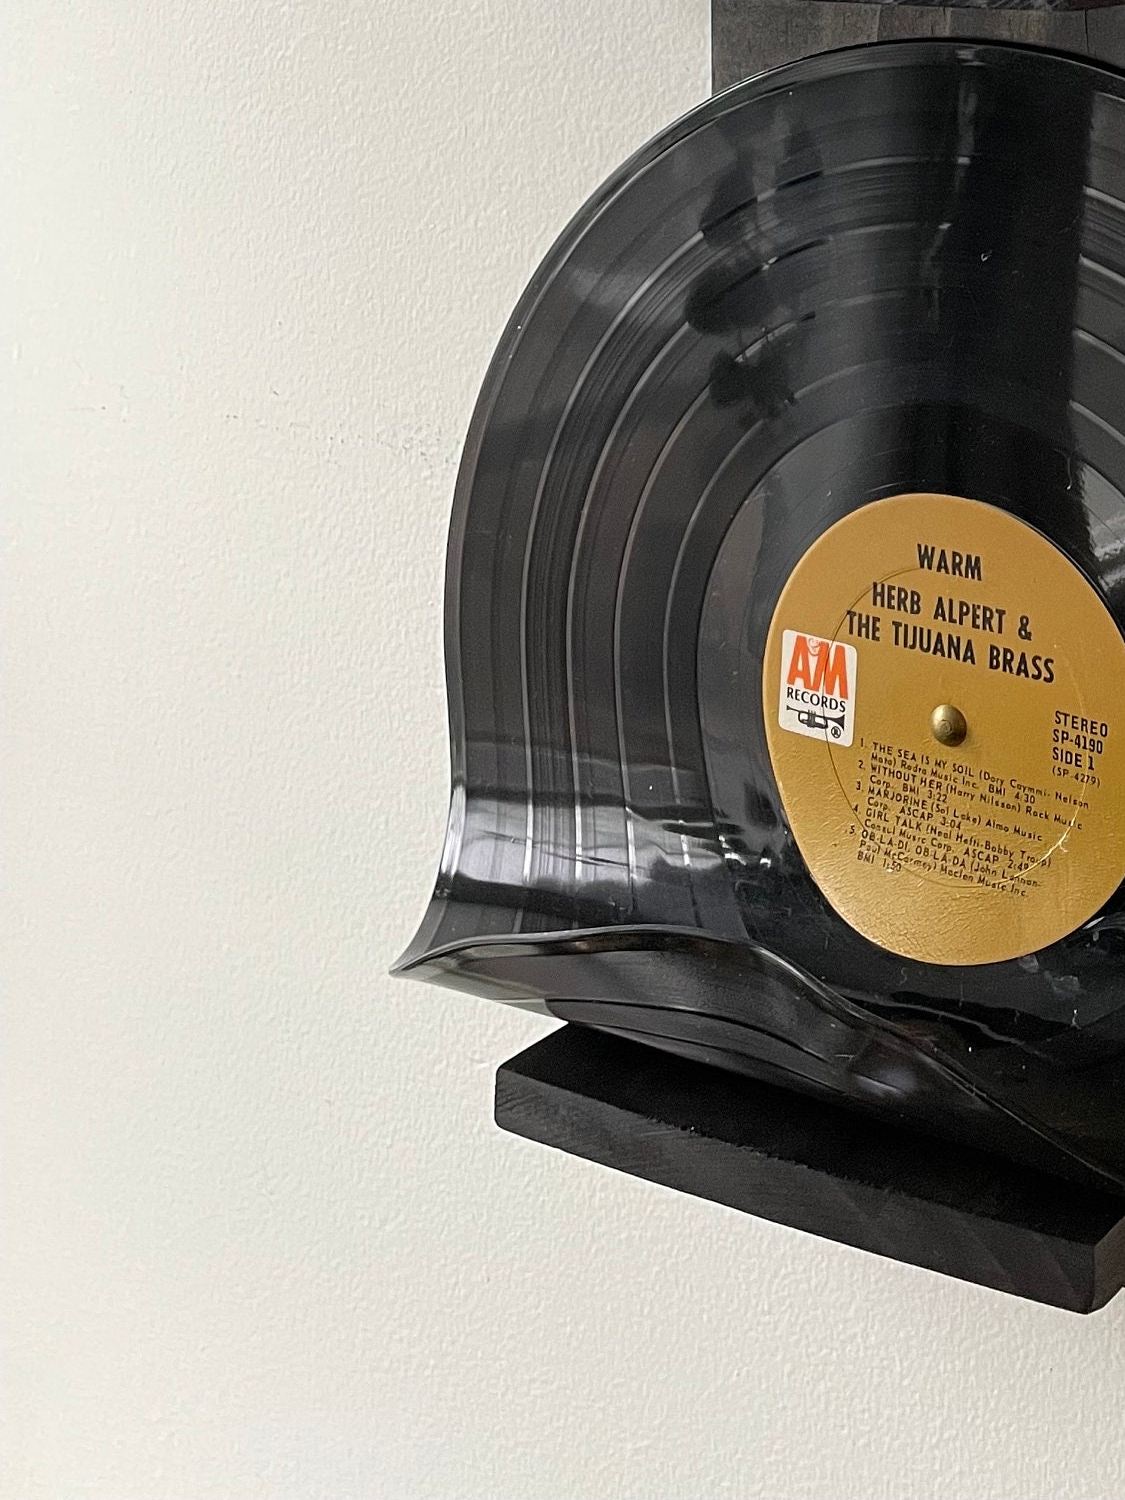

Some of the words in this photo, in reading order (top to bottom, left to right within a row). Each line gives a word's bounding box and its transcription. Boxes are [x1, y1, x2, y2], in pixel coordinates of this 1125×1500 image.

[916, 543, 983, 581] WARM
[872, 581, 921, 615] HERB
[933, 596, 1007, 634] ALPERT
[1018, 614, 1032, 641] &
[847, 609, 881, 642] THE
[891, 620, 976, 665] TIJUANA
[988, 643, 1055, 683] BRASS
[786, 686, 846, 713] RECORDS
[1054, 710, 1109, 738] STEREO
[1052, 728, 1103, 755] SP-4190
[872, 741, 893, 756] THE
[897, 748, 917, 762] SEA
[920, 754, 930, 765] IS
[934, 759, 948, 770] MY
[952, 763, 975, 778] SOIL
[979, 769, 1005, 786] (Dory
[1055, 791, 1090, 809] Nelson
[1052, 746, 1083, 768] SIDE
[1087, 755, 1095, 771] 1
[870, 763, 917, 784] WITHOUT
[920, 777, 943, 790] HER
[945, 784, 976, 801] (Harry
[979, 793, 1021, 813] Nilsson)
[902, 783, 920, 795] BMI
[927, 789, 948, 803] 3:22
[930, 768, 958, 784] Music
[988, 783, 1006, 797] BMI
[1014, 792, 1036, 805] 4:30
[865, 808, 890, 822] GIRL
[895, 815, 922, 831] TALK
[926, 823, 952, 839] (Neal
[867, 796, 891, 812] Corp.
[899, 805, 934, 822] ASCAP
[867, 785, 928, 810] MARJORINE
[930, 801, 950, 815] (Sol
[985, 819, 1010, 833] Almo
[1013, 825, 1043, 841] Music
[857, 850, 875, 865] BMI
[882, 858, 902, 873] 1:50
[899, 828, 926, 845] Music
[930, 837, 955, 853] Corp.
[963, 847, 1000, 864] ASCAP
[859, 839, 881, 855] Paul
[976, 874, 1007, 892] Music
[970, 859, 997, 877] (John
